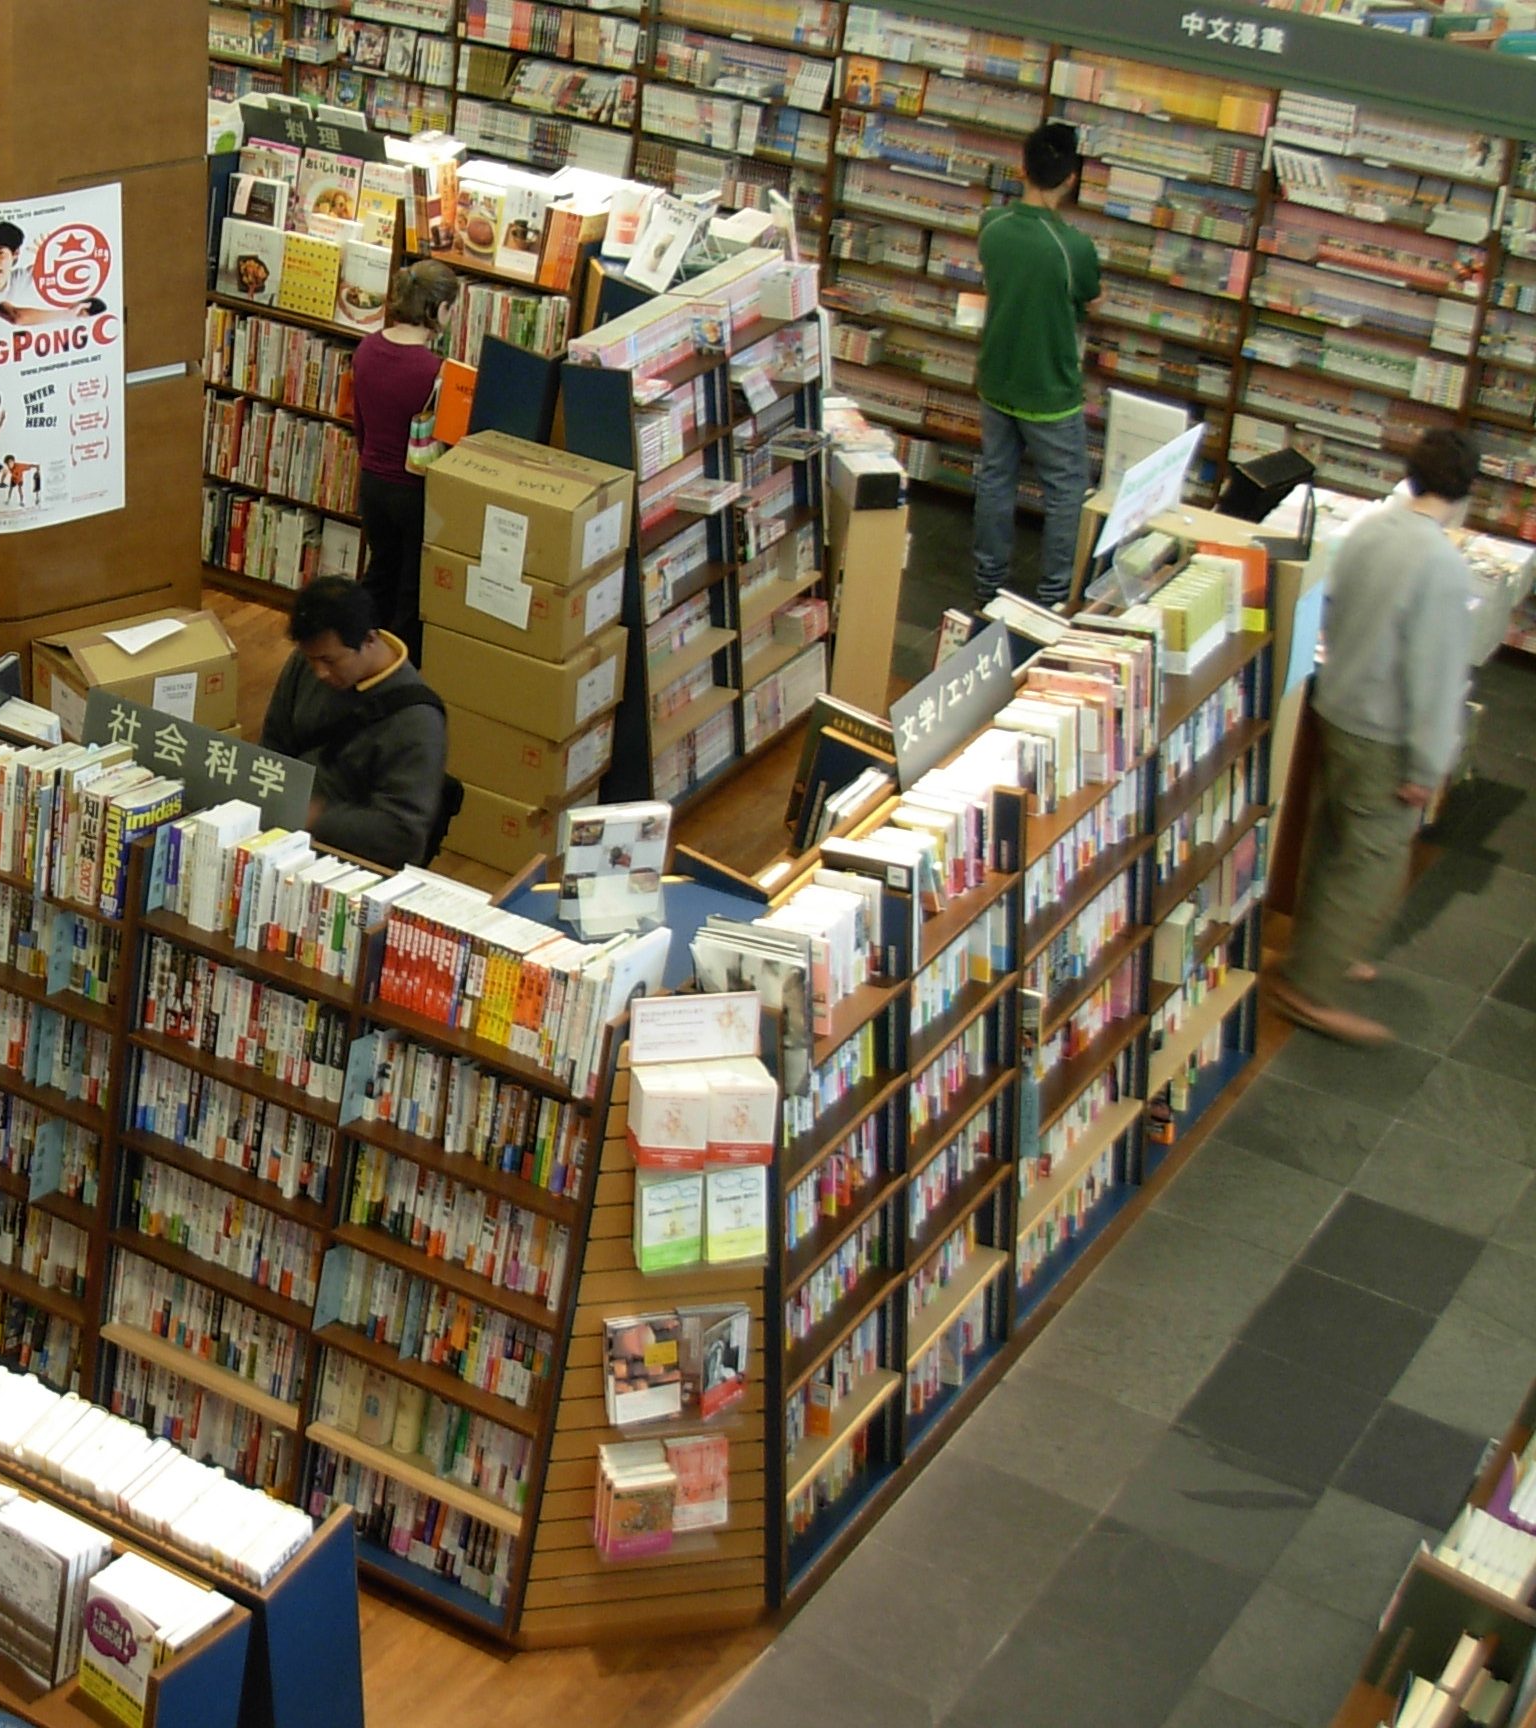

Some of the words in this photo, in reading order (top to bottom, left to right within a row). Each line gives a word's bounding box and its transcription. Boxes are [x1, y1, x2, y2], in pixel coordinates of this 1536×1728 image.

[1180, 12, 1285, 54] 中文漫畫
[285, 119, 342, 150] 料理
[12, 325, 88, 362] PONG
[23, 384, 56, 404] ENTER
[25, 402, 45, 416] THE
[25, 416, 57, 428] HERO!
[899, 637, 1004, 752] 文学/エッセイ
[107, 703, 286, 798] 社会科学
[125, 798, 182, 831] imidas
[102, 804, 123, 896] imidas
[79, 860, 93, 897] 2007
